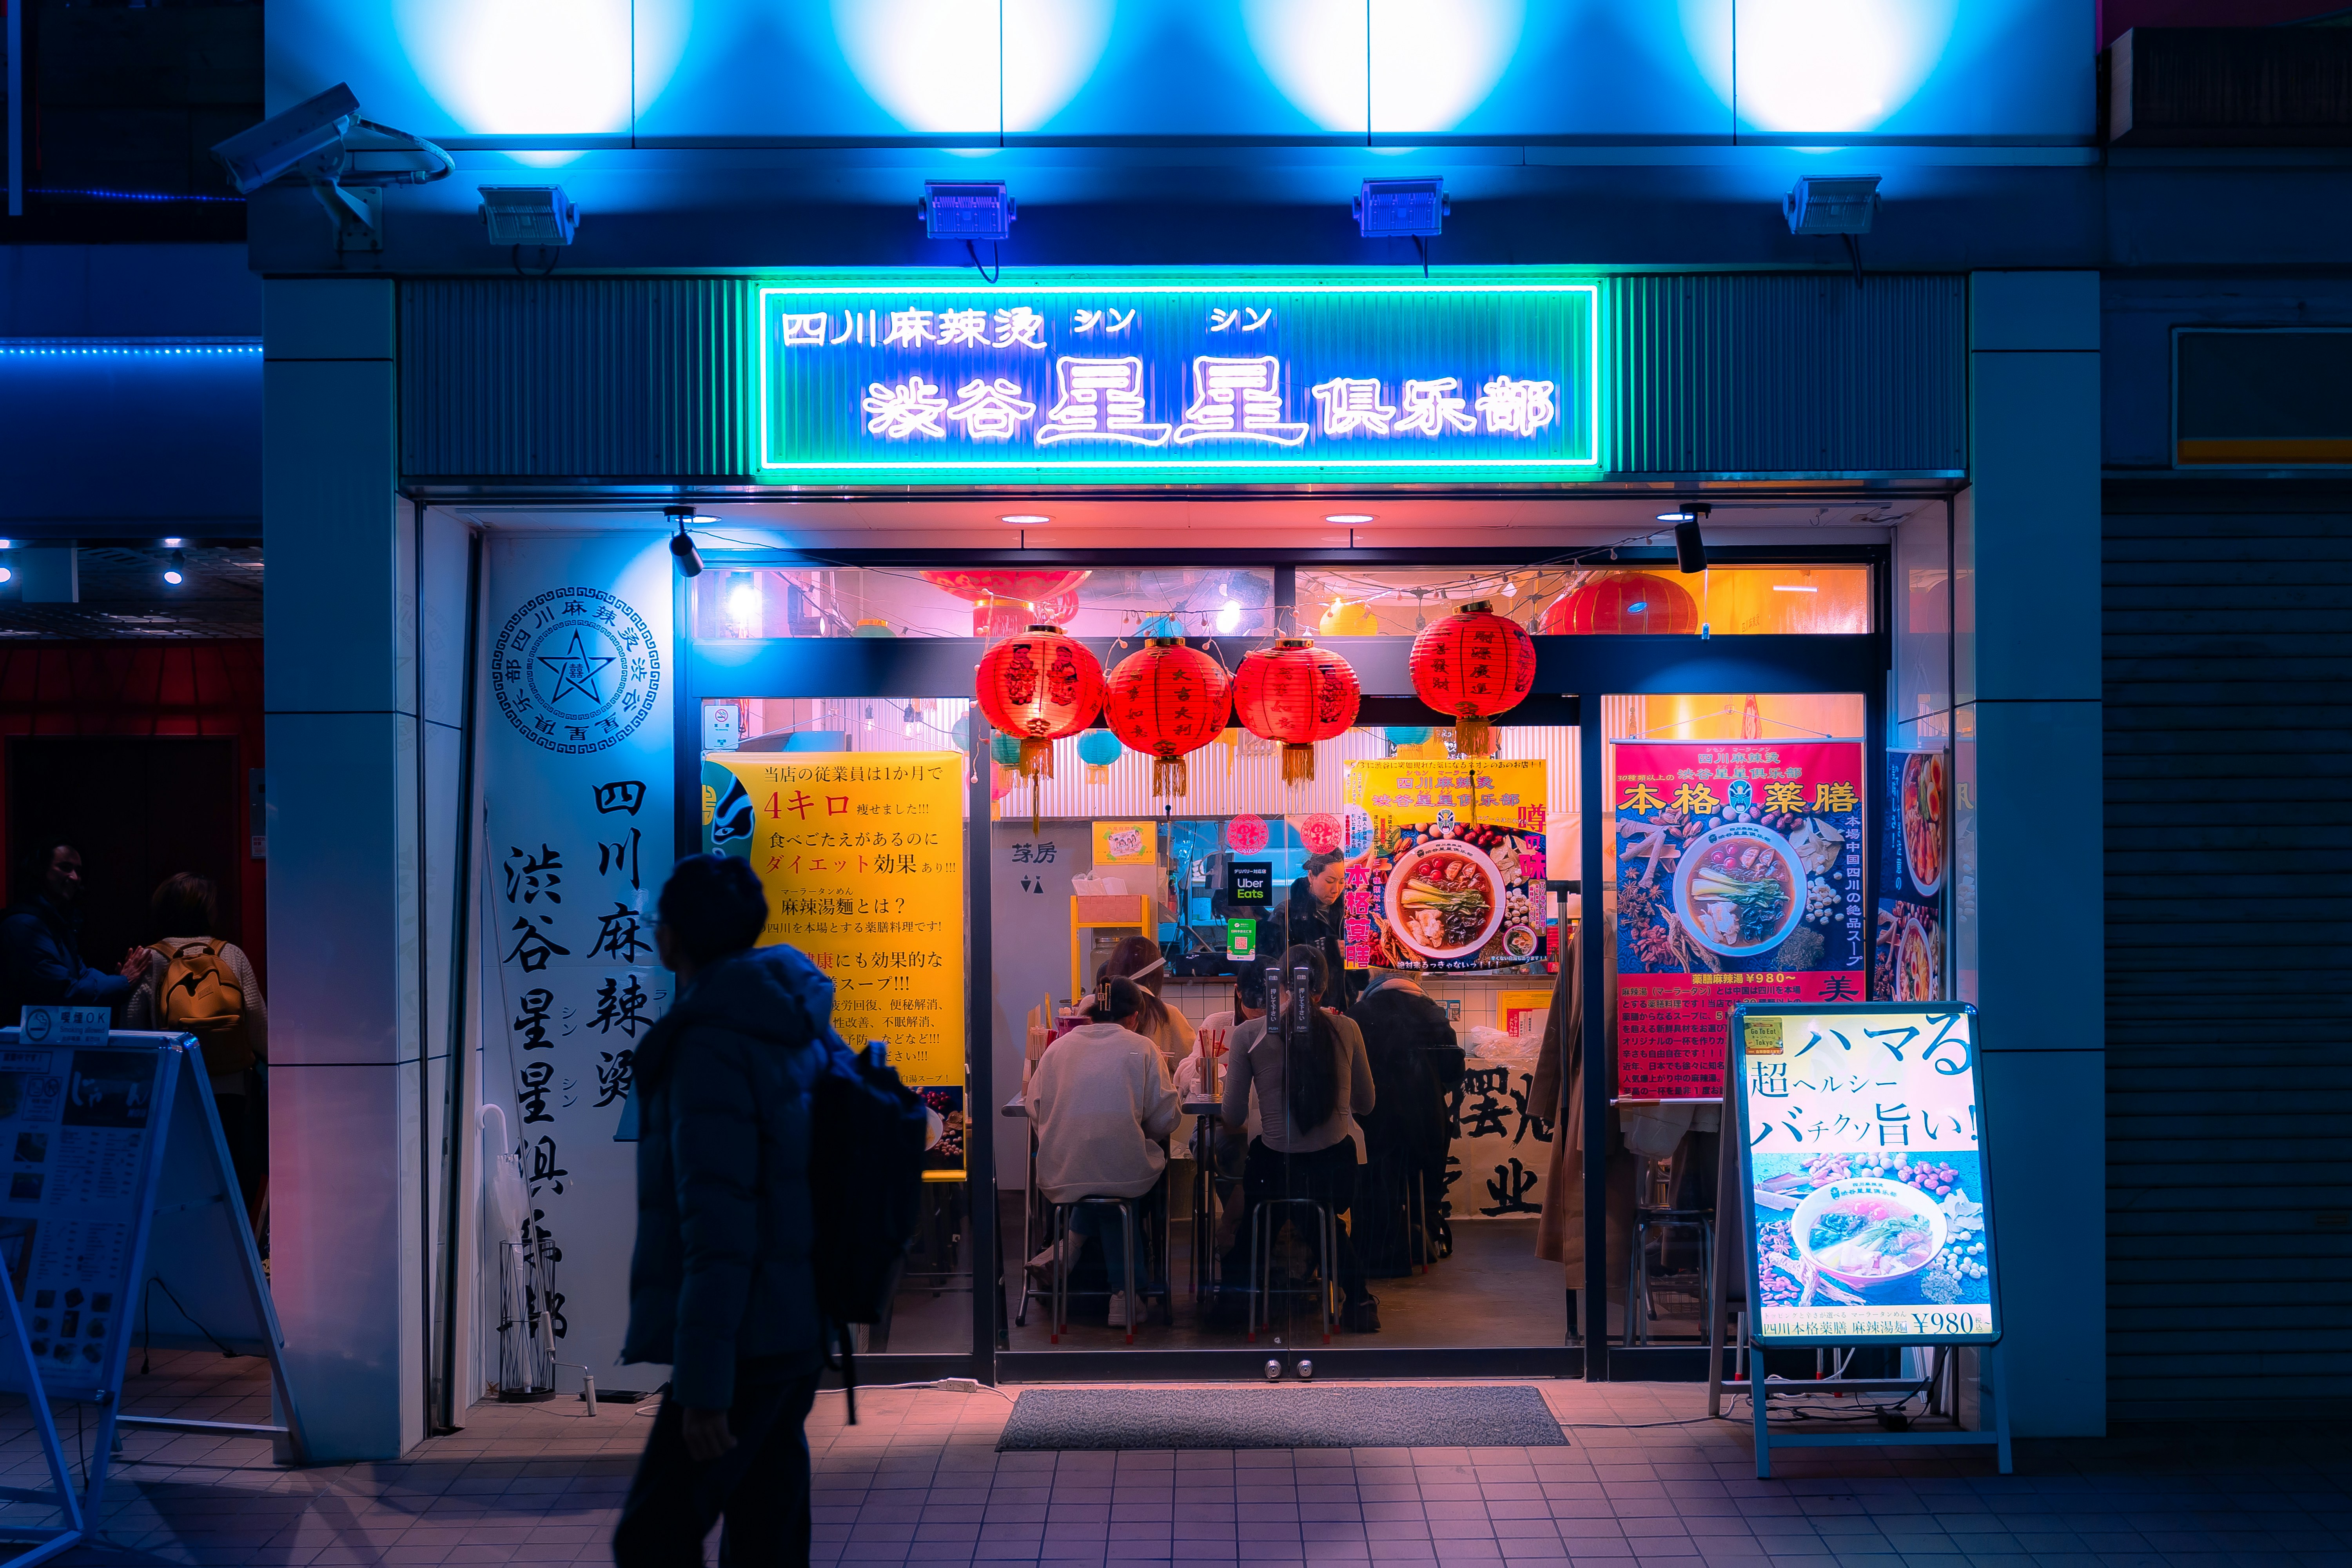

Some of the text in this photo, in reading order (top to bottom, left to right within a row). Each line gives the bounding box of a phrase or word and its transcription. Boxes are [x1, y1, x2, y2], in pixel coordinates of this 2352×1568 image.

[1074, 308, 1273, 332] シン シン
[1172, 669, 1192, 735] 大吉大利
[764, 766, 943, 783] 当店の従業員は1か月で
[764, 790, 849, 820] 4キロ
[768, 831, 938, 849] 食べごたえがあるのに
[766, 853, 917, 874] ダイエット効果
[1012, 841, 1057, 864] 茅房
[781, 887, 853, 895] マーラータンめん
[1237, 878, 1263, 888] Uber
[1237, 889, 1263, 898] Eats
[1845, 816, 1863, 966] 本場中国四川の絶品スープ
[1345, 864, 1371, 968] 本格薬膳
[59, 1026, 83, 1034] Smoking
[562, 1006, 577, 1036] シン
[1794, 1013, 1972, 1075] ハマる
[1751, 1061, 1897, 1098] 超ヘルシー
[562, 1078, 578, 1108] シン
[1763, 1321, 1847, 1336] 四川本格薬膳
